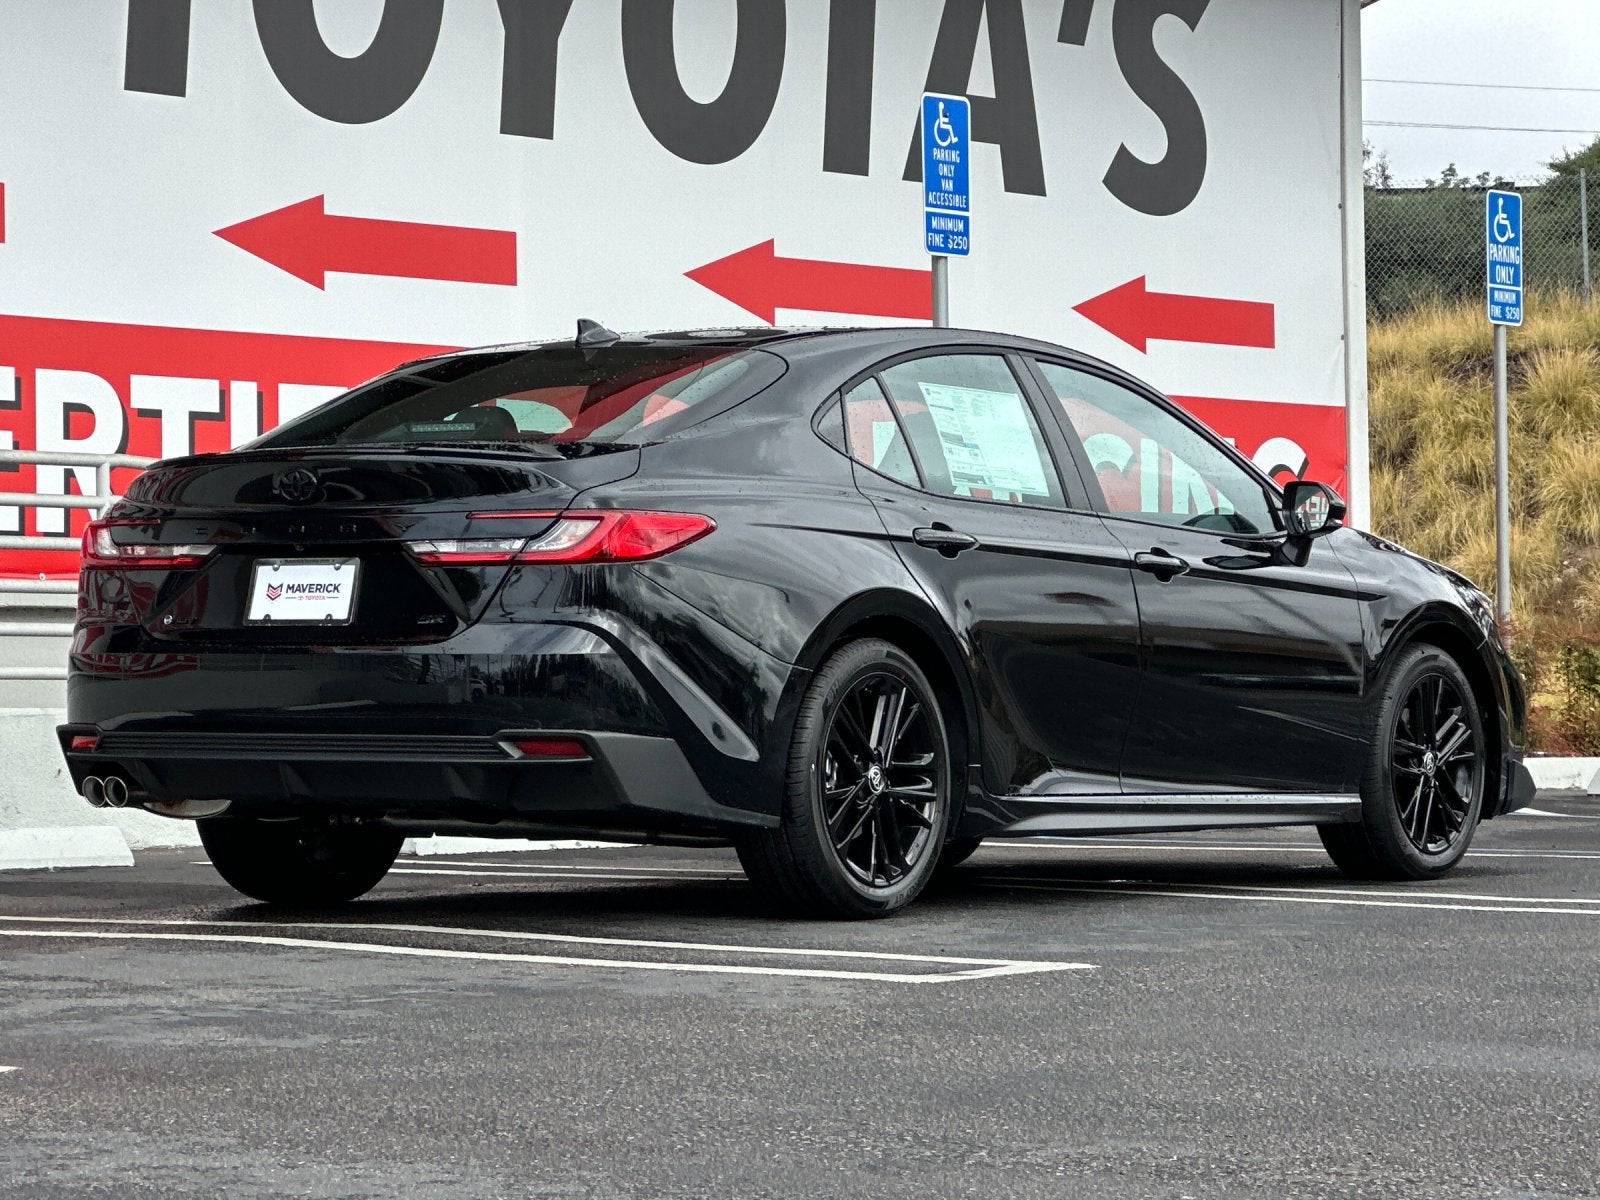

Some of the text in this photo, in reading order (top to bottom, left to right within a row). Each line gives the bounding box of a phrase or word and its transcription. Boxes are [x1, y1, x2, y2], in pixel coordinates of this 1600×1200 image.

[933, 148, 960, 162] PARKING
[939, 164, 954, 177] ONLY
[941, 179, 953, 191] VAN
[929, 192, 966, 208] ACCESSIBLE
[932, 216, 964, 232] MINIMUM
[928, 233, 967, 249] FINE $250
[1490, 244, 1519, 264] PARKING
[1496, 265, 1514, 284] ONLY
[1491, 305, 1519, 319] FINE $250
[286, 583, 341, 593] MAVERICK
